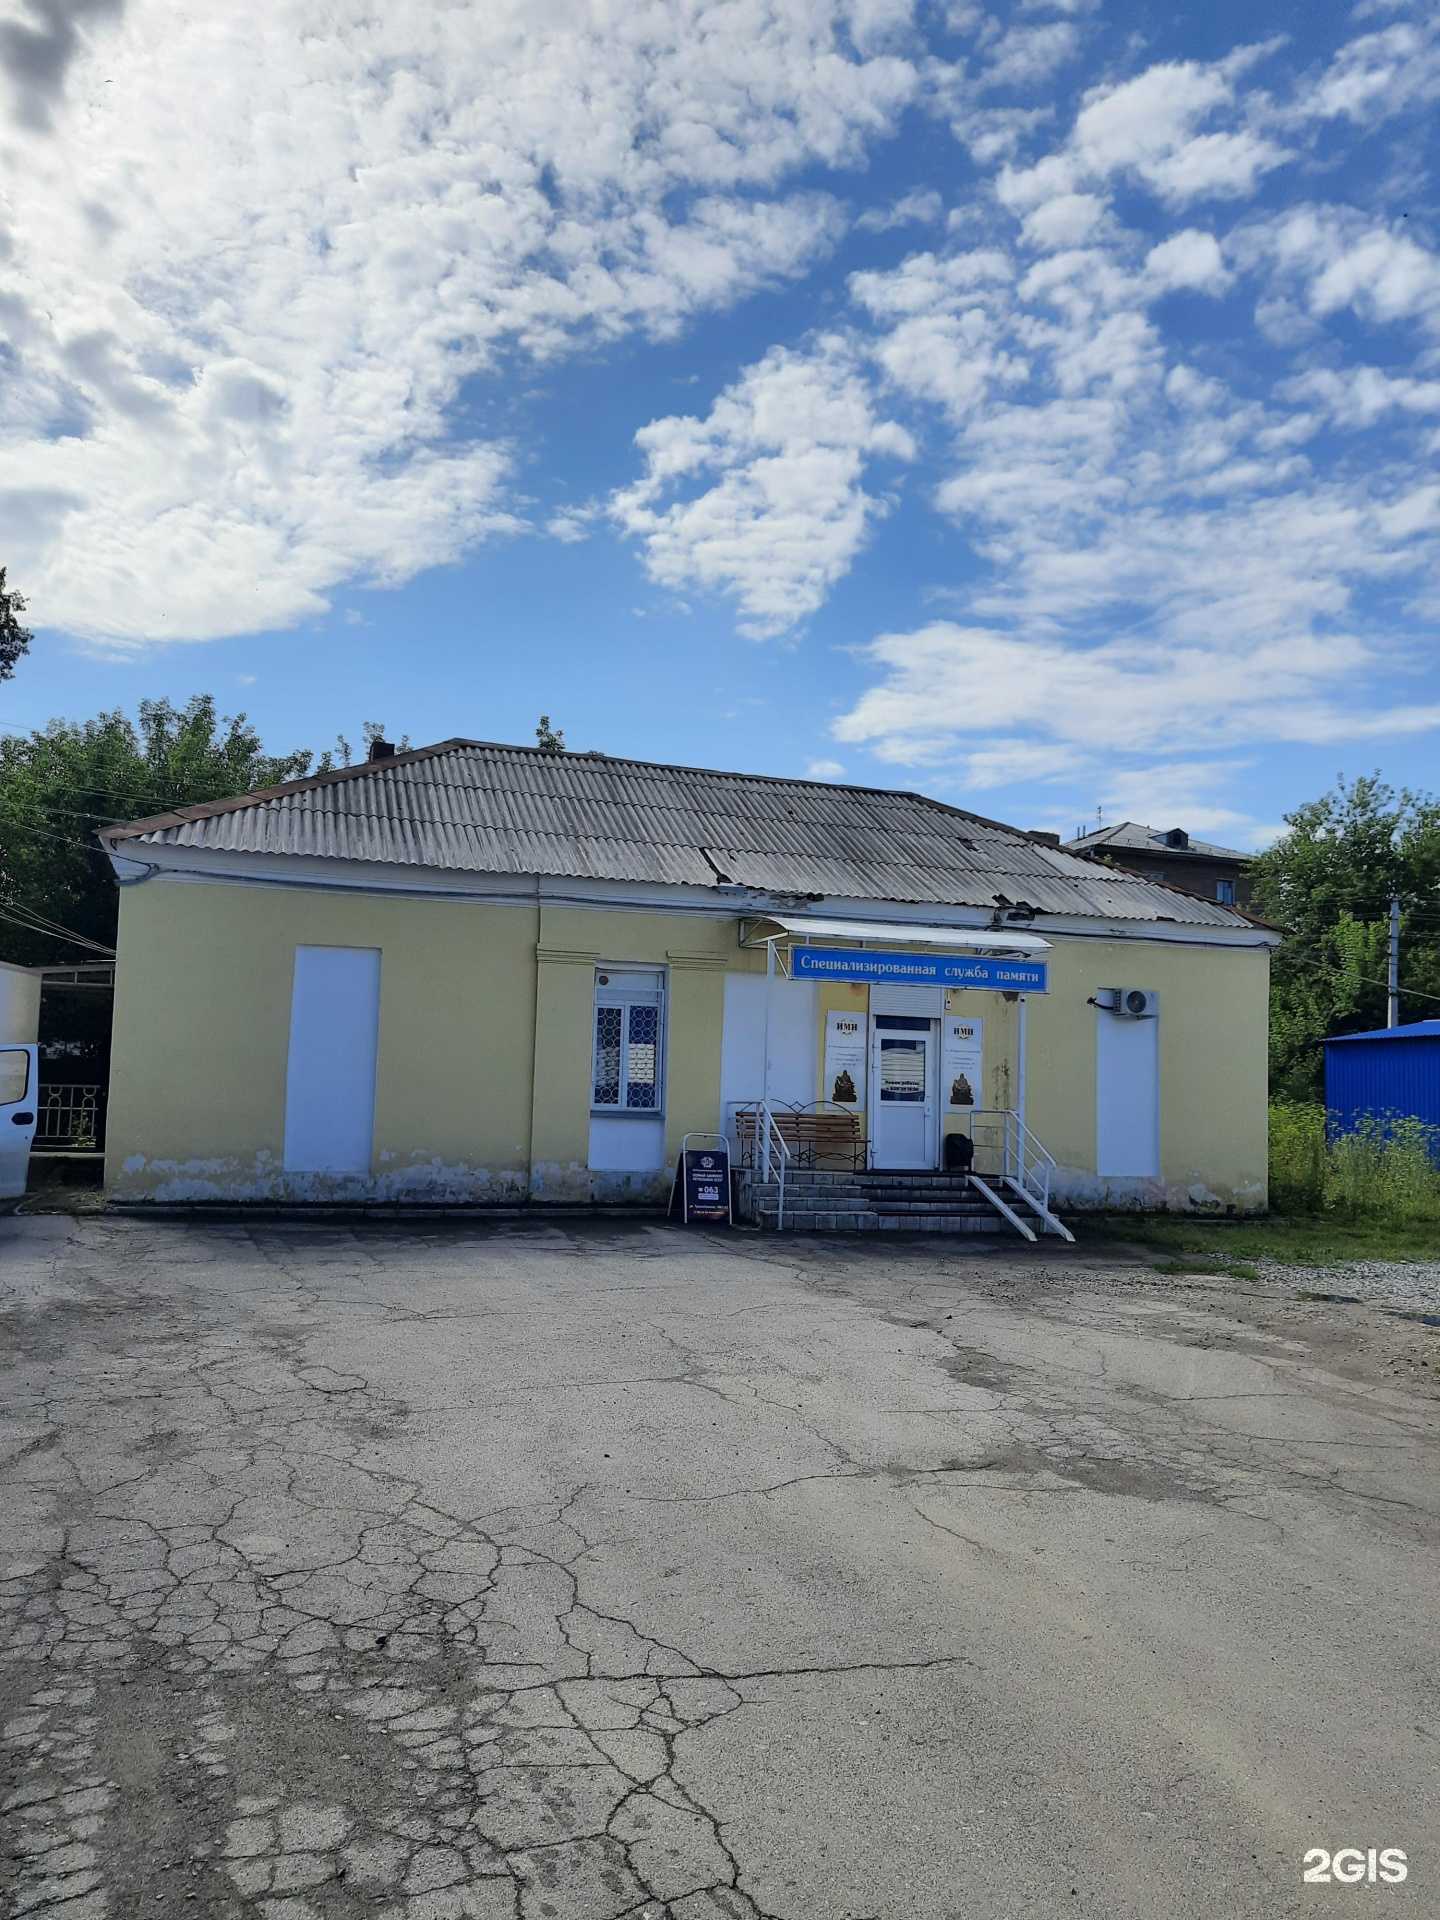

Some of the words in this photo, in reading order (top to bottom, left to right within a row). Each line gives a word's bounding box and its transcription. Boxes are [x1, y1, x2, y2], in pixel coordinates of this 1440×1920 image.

[800, 955, 936, 976] Специализированная
[944, 965, 988, 980] служба
[996, 970, 1039, 982] памяти
